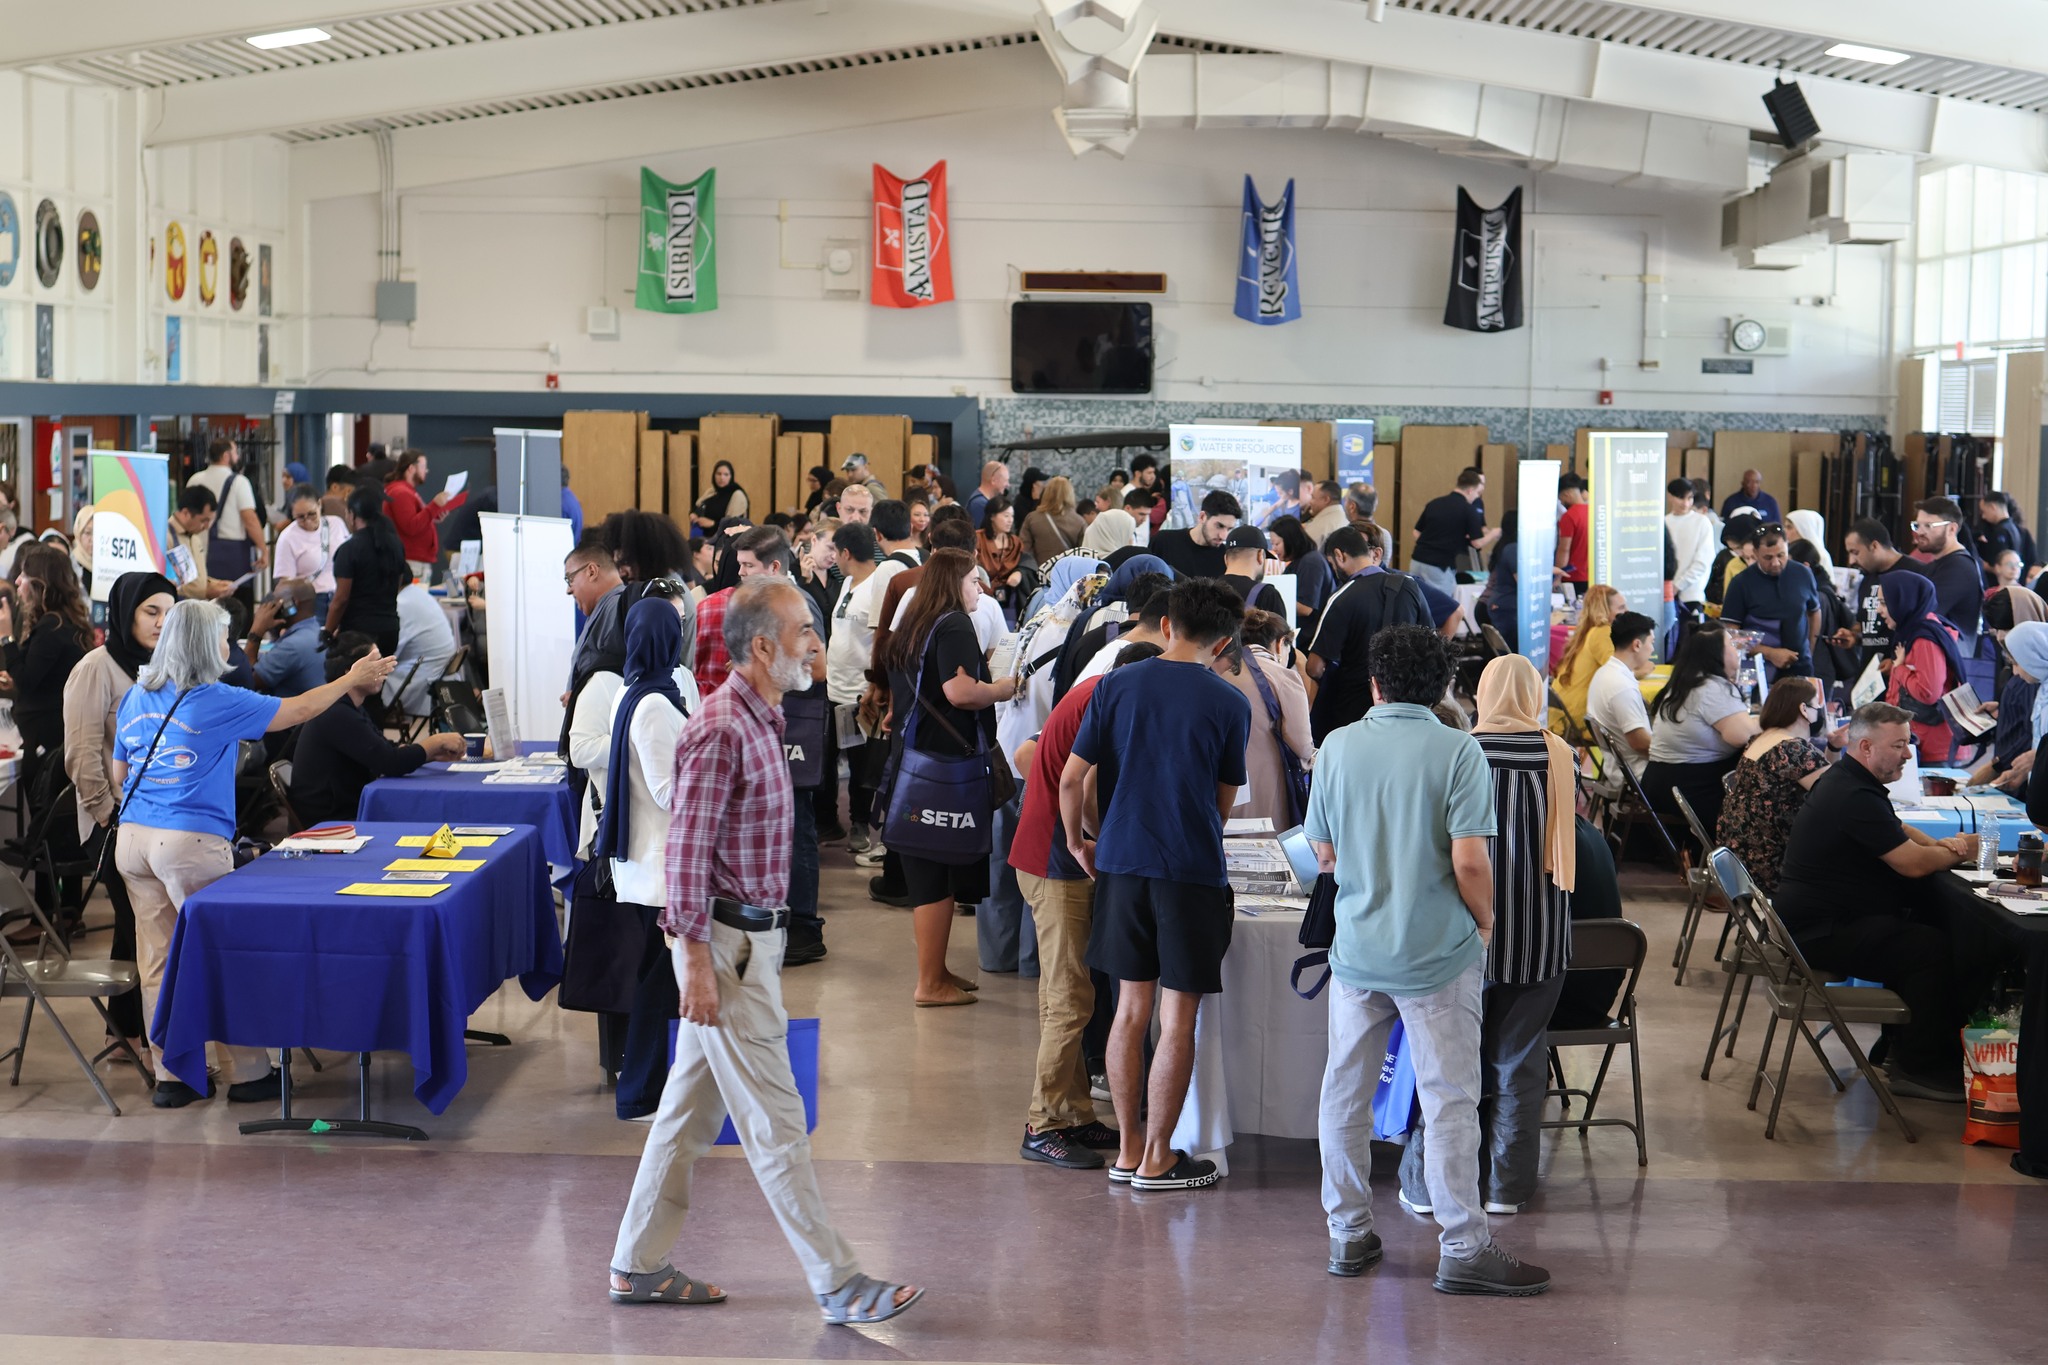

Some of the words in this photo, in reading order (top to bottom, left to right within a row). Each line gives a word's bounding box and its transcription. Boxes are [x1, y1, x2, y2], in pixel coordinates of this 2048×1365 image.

[667, 190, 696, 301] ISIBINDI
[903, 180, 932, 298] AMISTAD
[1199, 443, 1233, 453] WATER
[1235, 443, 1295, 455] RESOURCES
[112, 537, 137, 560] SETA
[1597, 505, 1607, 584] nsportation
[920, 808, 976, 829] SETA
[1186, 1173, 1216, 1187] crocs
